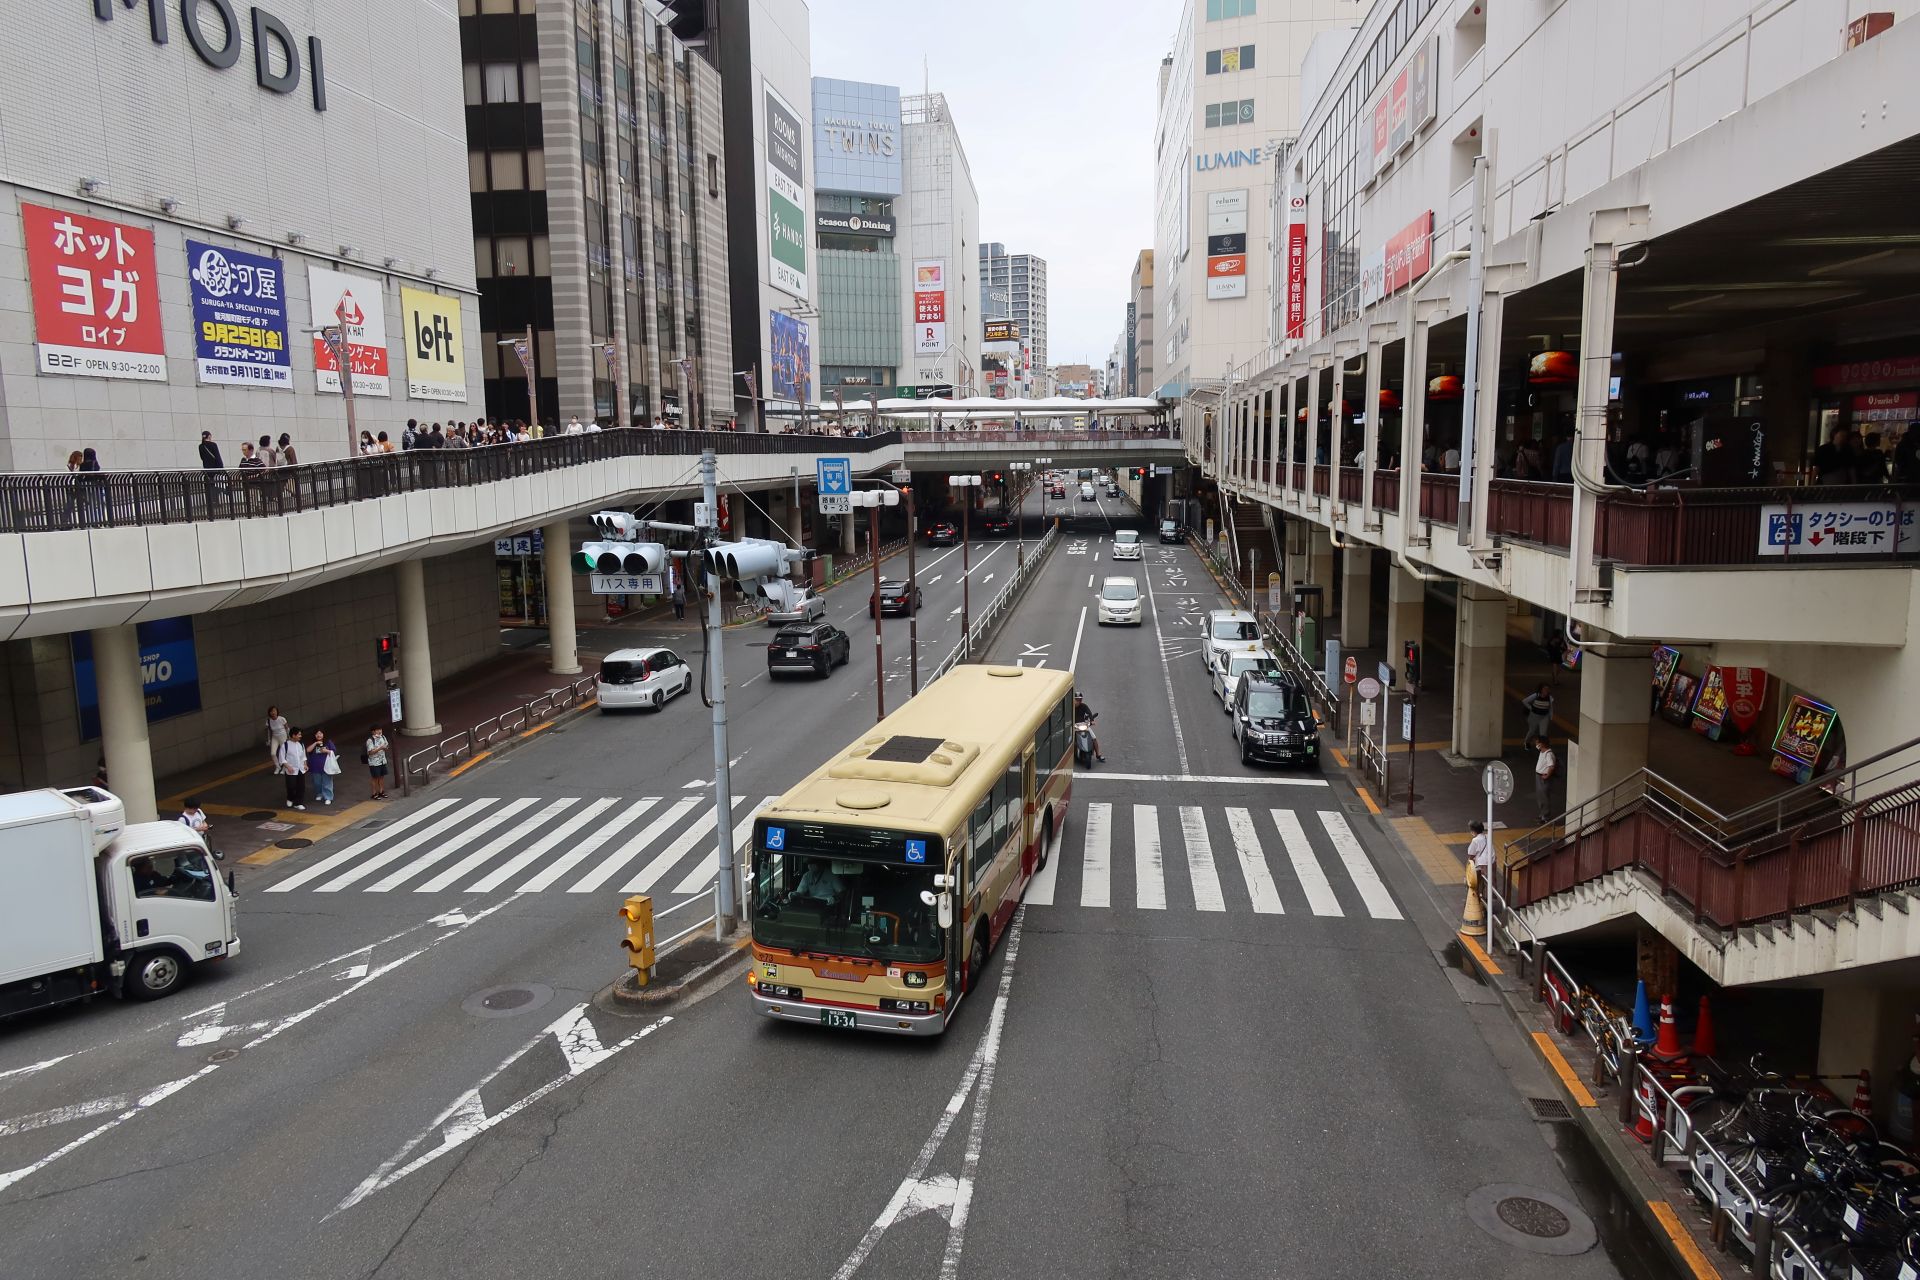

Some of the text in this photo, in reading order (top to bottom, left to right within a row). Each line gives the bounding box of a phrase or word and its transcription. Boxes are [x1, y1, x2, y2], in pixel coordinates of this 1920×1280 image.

[774, 112, 797, 146] ROOMS
[868, 121, 895, 132] TOKYU
[824, 127, 896, 157] TWINS
[1196, 147, 1262, 172] LUMINE
[774, 173, 787, 190] EAST
[818, 217, 892, 232] Season Dining
[53, 216, 136, 265] ホット
[782, 223, 803, 249] HANDS
[778, 266, 790, 282] EAST
[57, 265, 140, 323] ヨガ
[201, 297, 281, 317] SURUGA-YA SPECIALTY STORE
[82, 325, 127, 346] ロイブ
[47, 353, 82, 368] B2F
[326, 377, 338, 386] 4F
[920, 371, 944, 380] TWINS
[1808, 509, 1915, 528] タクシーのりば
[1833, 530, 1886, 546] 階段下
[600, 577, 653, 590] バス専用
